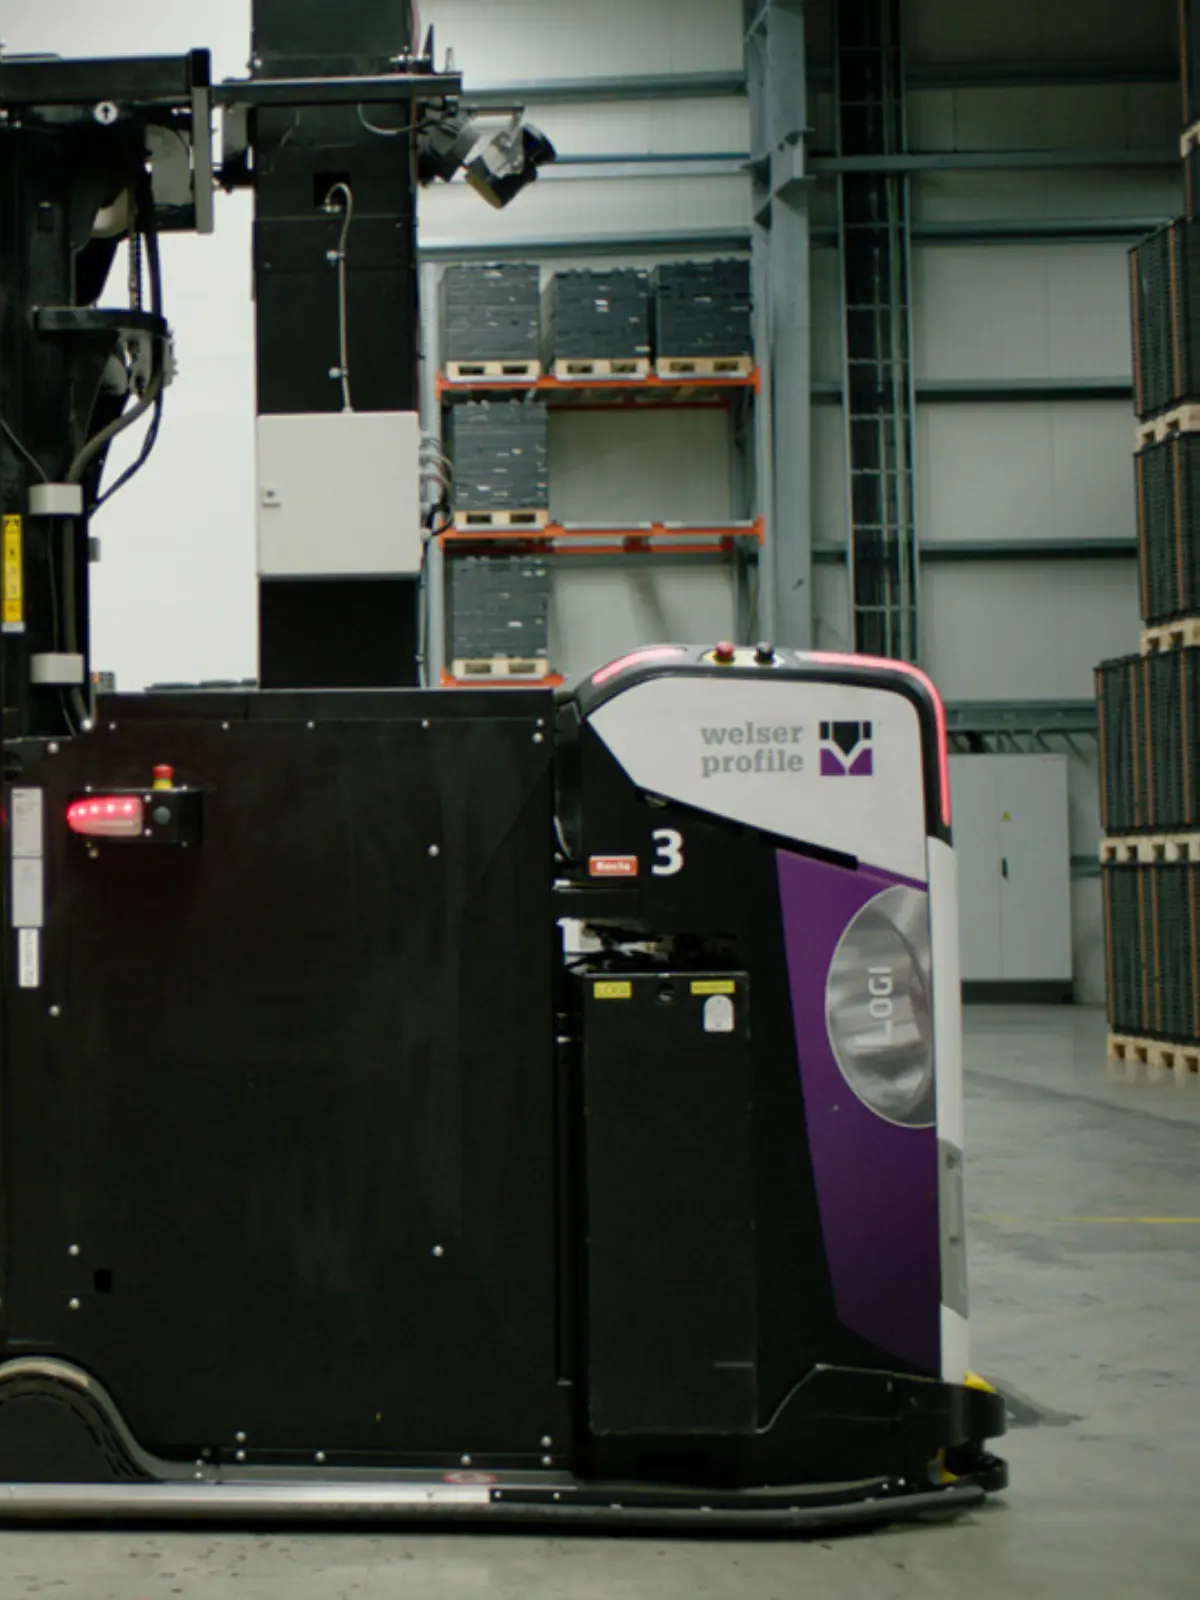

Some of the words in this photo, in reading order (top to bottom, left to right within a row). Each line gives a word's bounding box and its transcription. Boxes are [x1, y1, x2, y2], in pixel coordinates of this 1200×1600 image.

[700, 721, 803, 745] welser
[701, 749, 805, 778] profile
[651, 828, 684, 876] 3
